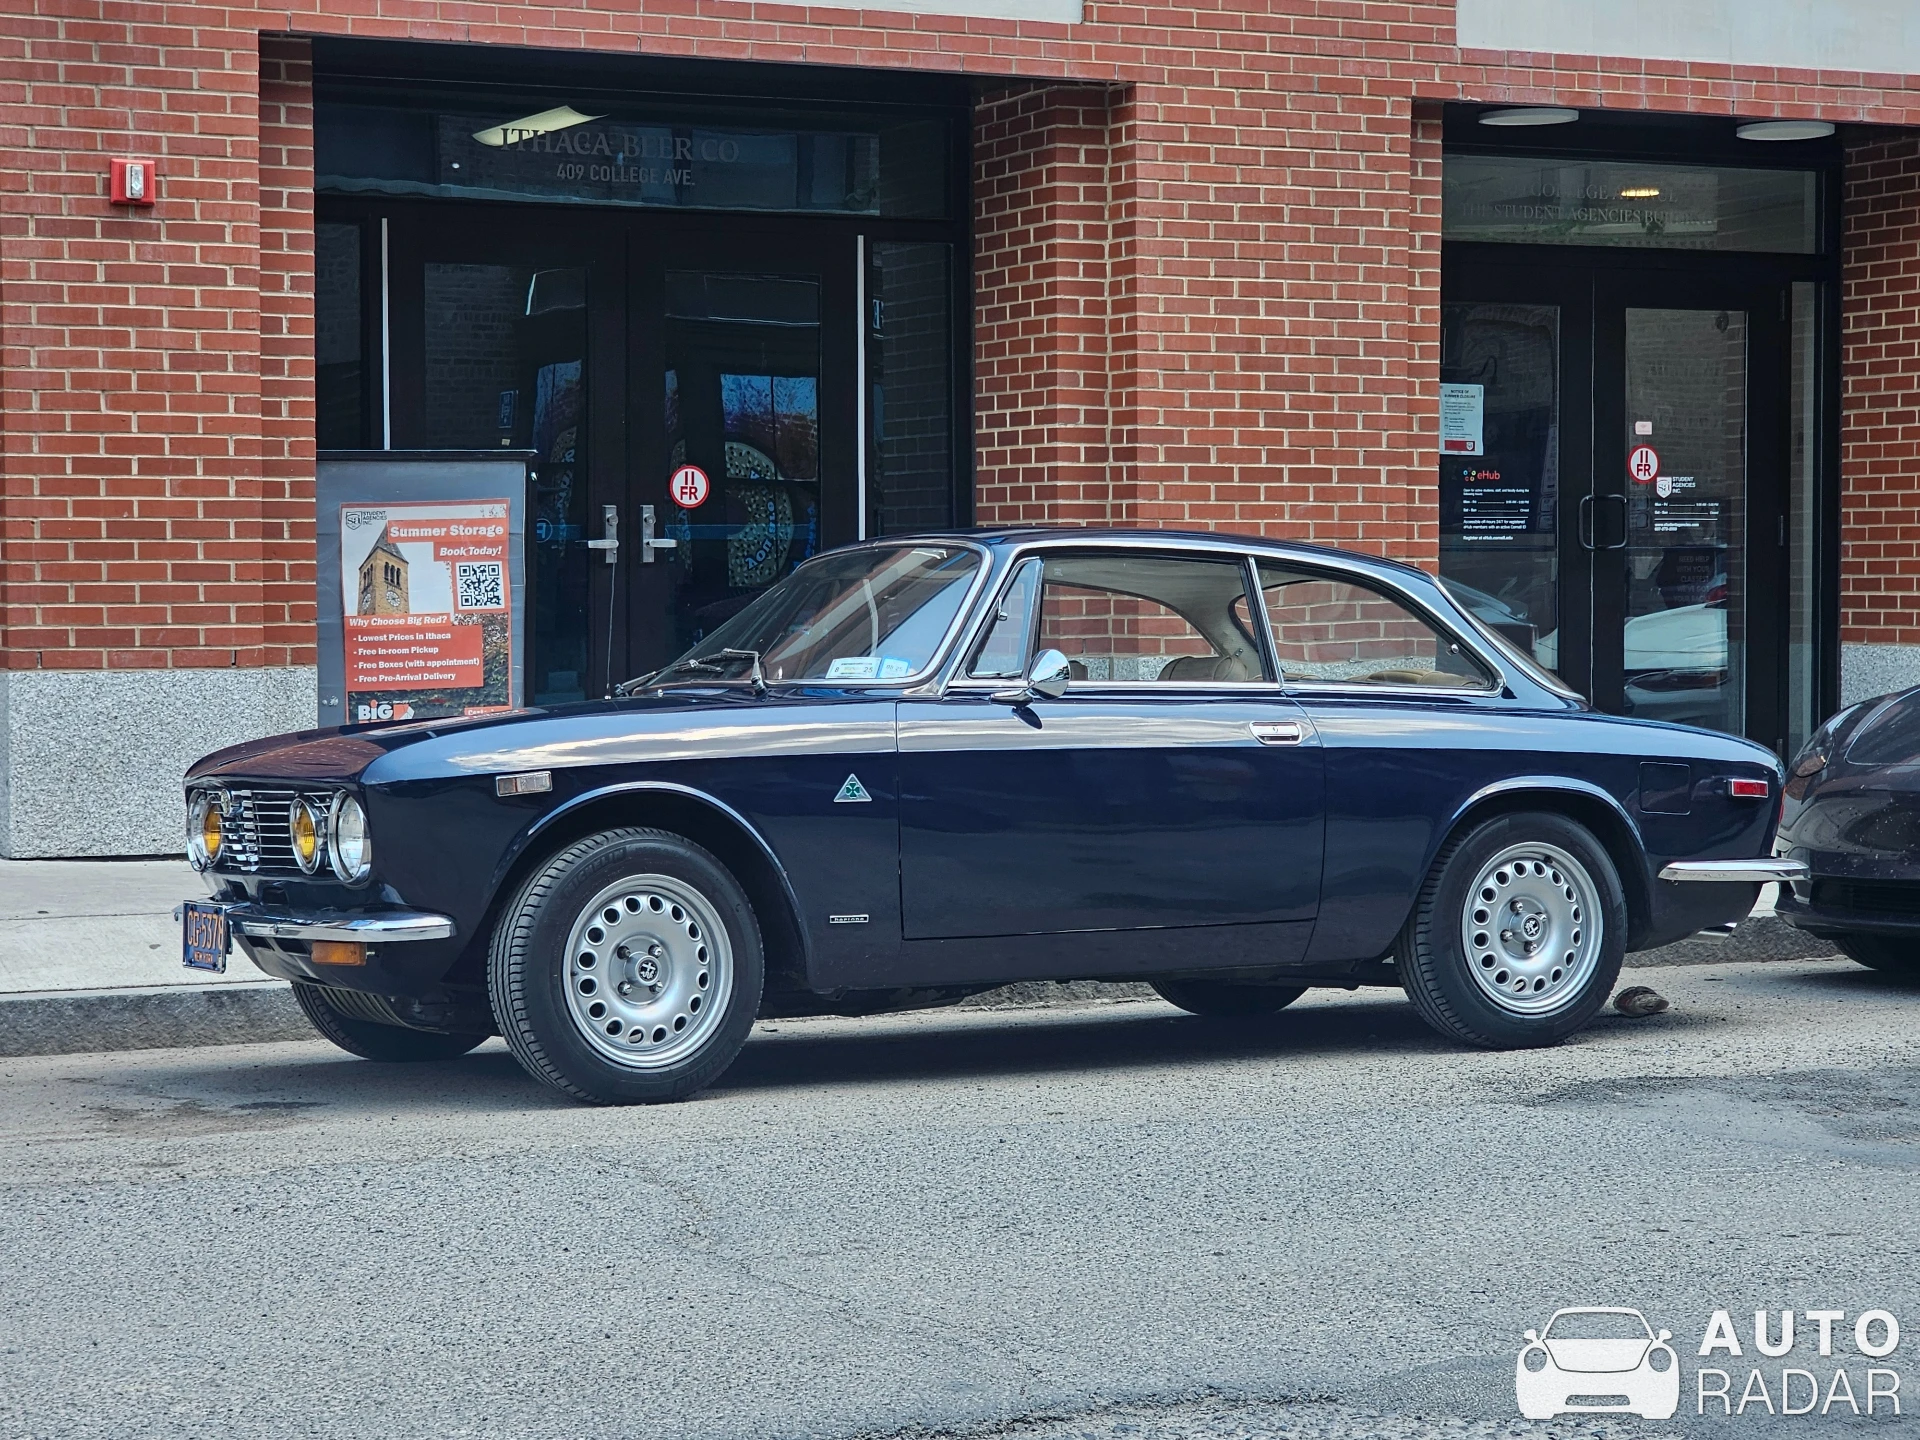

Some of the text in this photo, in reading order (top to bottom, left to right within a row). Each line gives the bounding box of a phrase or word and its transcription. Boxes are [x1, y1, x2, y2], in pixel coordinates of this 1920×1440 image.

[500, 128, 611, 156] ITHACA
[700, 138, 741, 163] CO
[556, 163, 696, 187] 409 COLLEGE AVE.
[1493, 204, 1562, 219] STUDENT
[1567, 207, 1641, 223] AGENCIES
[1477, 470, 1500, 480] eHub
[1637, 463, 1651, 476] FR
[680, 486, 698, 500] FR
[390, 525, 504, 538] Summer Storage
[439, 546, 502, 557] Book Today!
[349, 615, 448, 628] Why Choose Big Red?
[358, 634, 387, 642] Lowest
[389, 633, 414, 641] Prices
[425, 632, 451, 640] Ithaca
[411, 646, 439, 654] Pickup
[379, 661, 404, 669] Boxes
[405, 659, 425, 669] (with
[427, 658, 480, 668] appointment)
[359, 672, 456, 683] Free Pre-Arrival Delivery
[563, 848, 627, 897] MICHELIN
